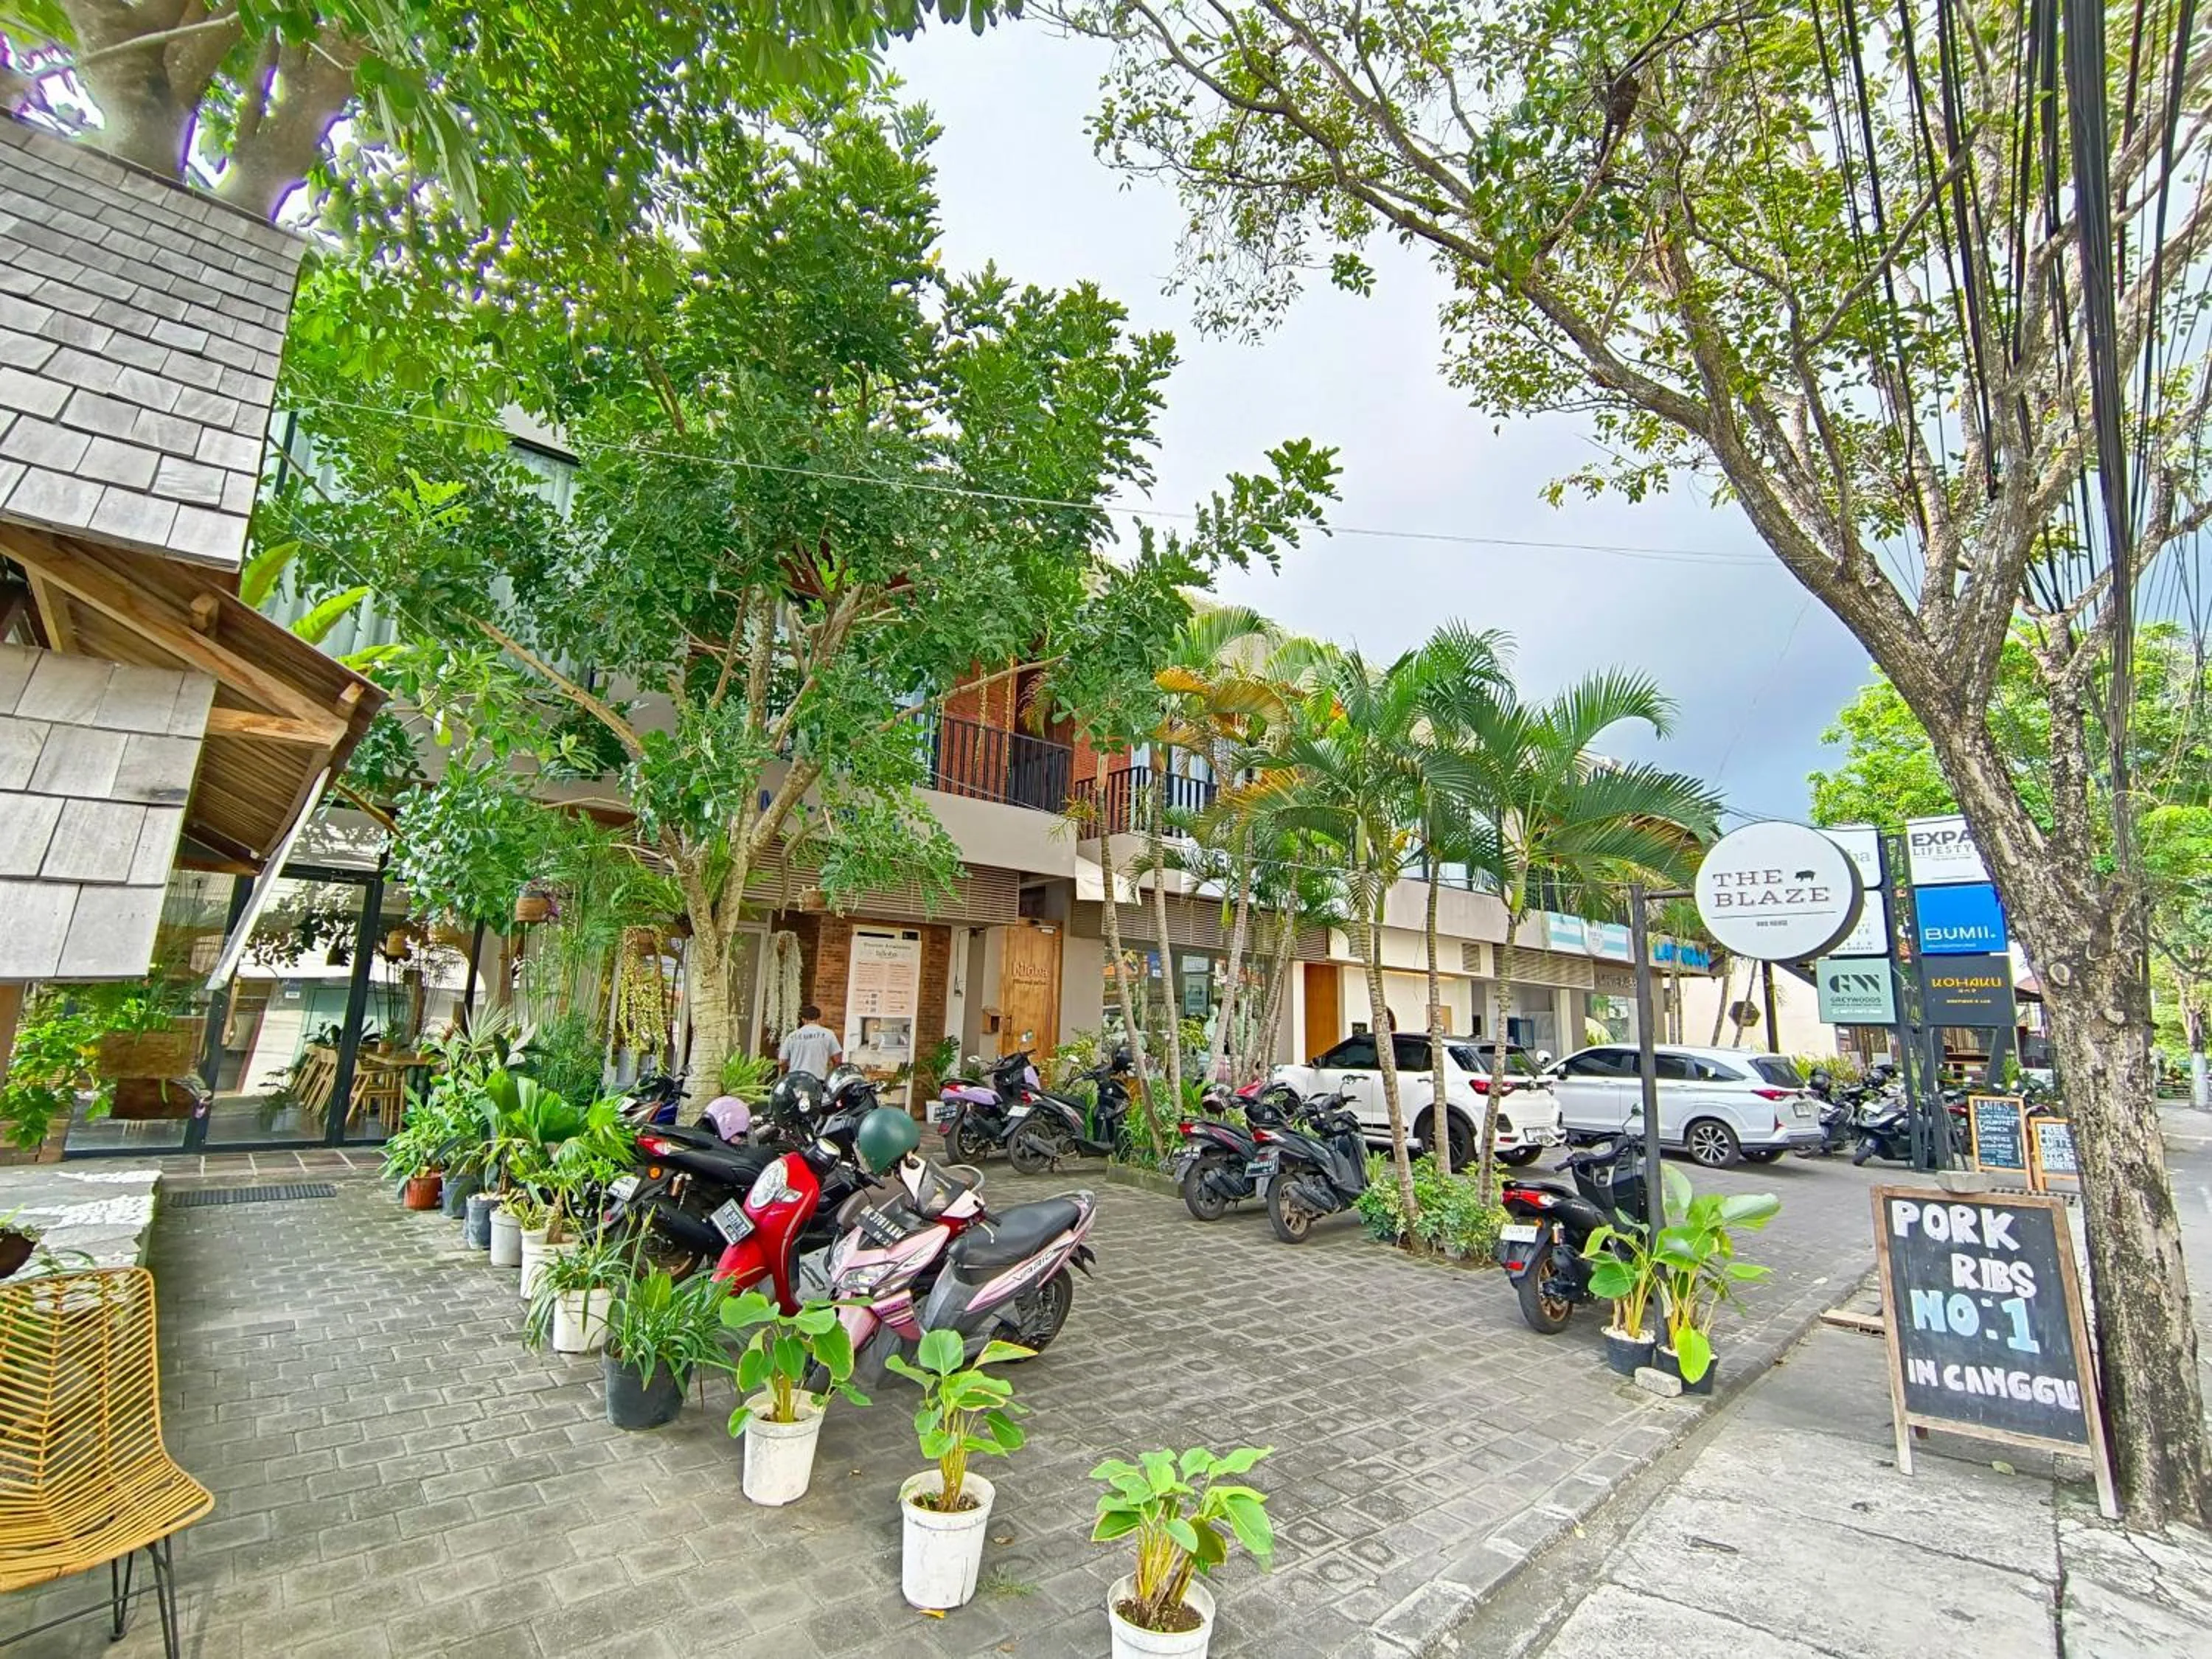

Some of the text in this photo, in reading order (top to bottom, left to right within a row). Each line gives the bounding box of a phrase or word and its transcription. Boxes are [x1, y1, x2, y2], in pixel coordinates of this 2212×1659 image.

[1713, 869, 1782, 887] THE
[1714, 887, 1830, 908] BLAZE
[1932, 977, 2001, 987] KOHAKU
[1891, 1200, 2020, 1252] PORK
[1950, 1253, 2037, 1298] RIBS
[1907, 1359, 2083, 1411] IN CANGGU
